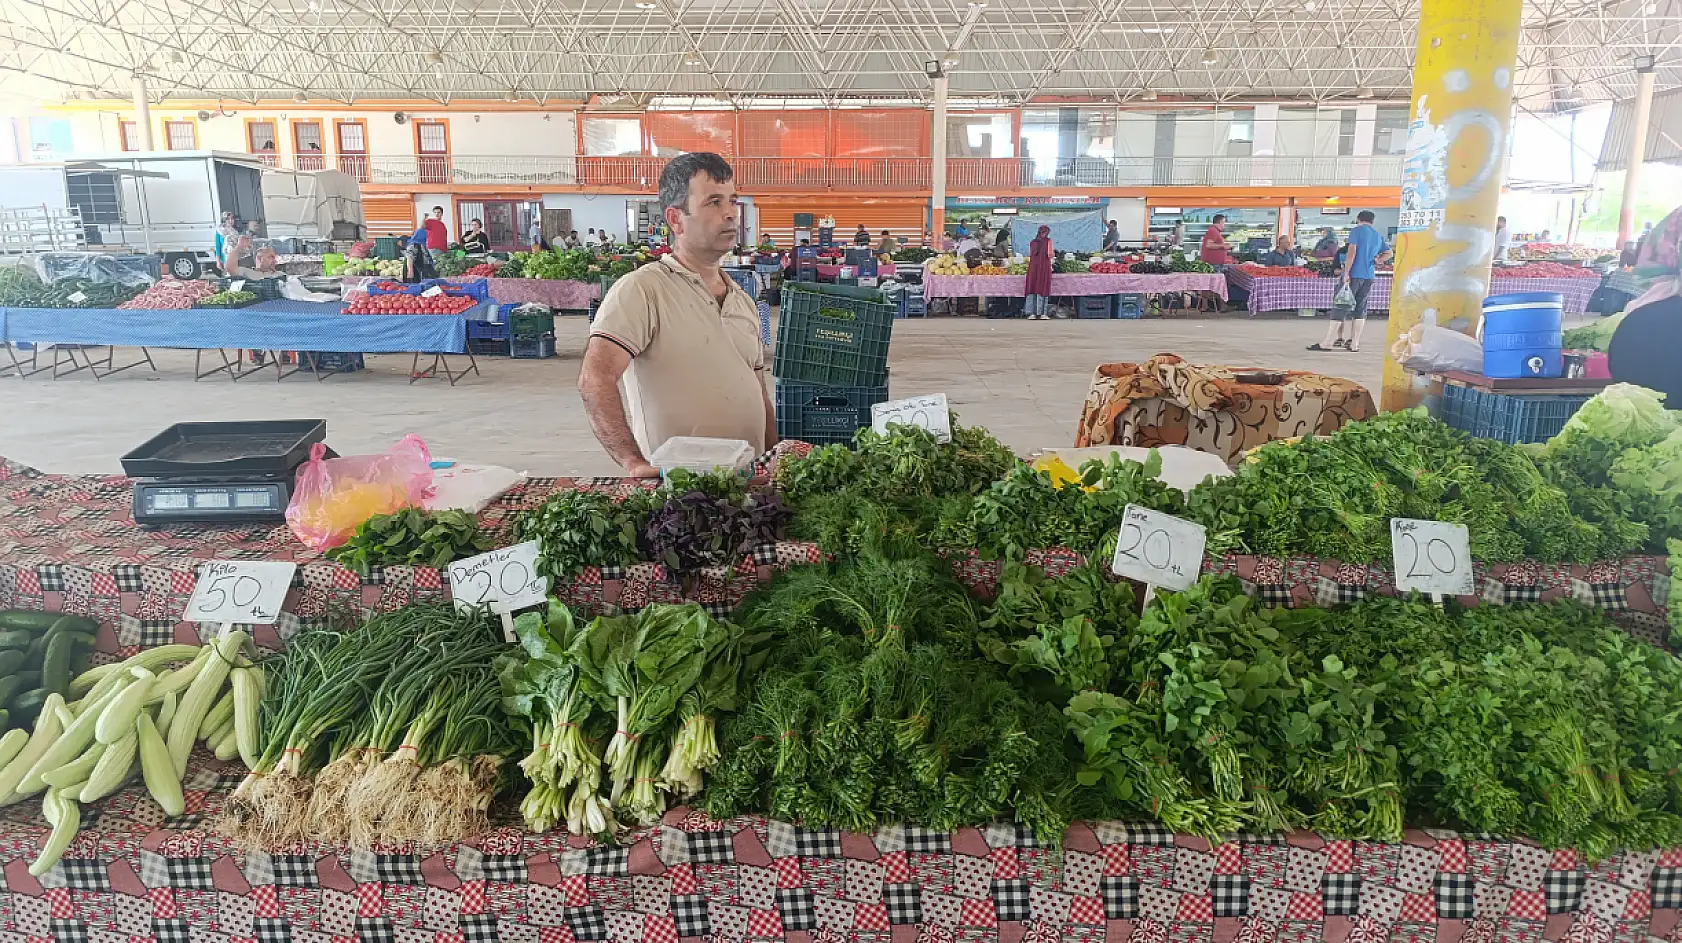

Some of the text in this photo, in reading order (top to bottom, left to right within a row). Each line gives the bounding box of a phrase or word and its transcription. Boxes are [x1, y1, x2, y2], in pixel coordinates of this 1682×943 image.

[1119, 523, 1171, 570] 20
[1402, 532, 1456, 578] 20
[199, 575, 262, 613] 50
[469, 560, 529, 604] 20
